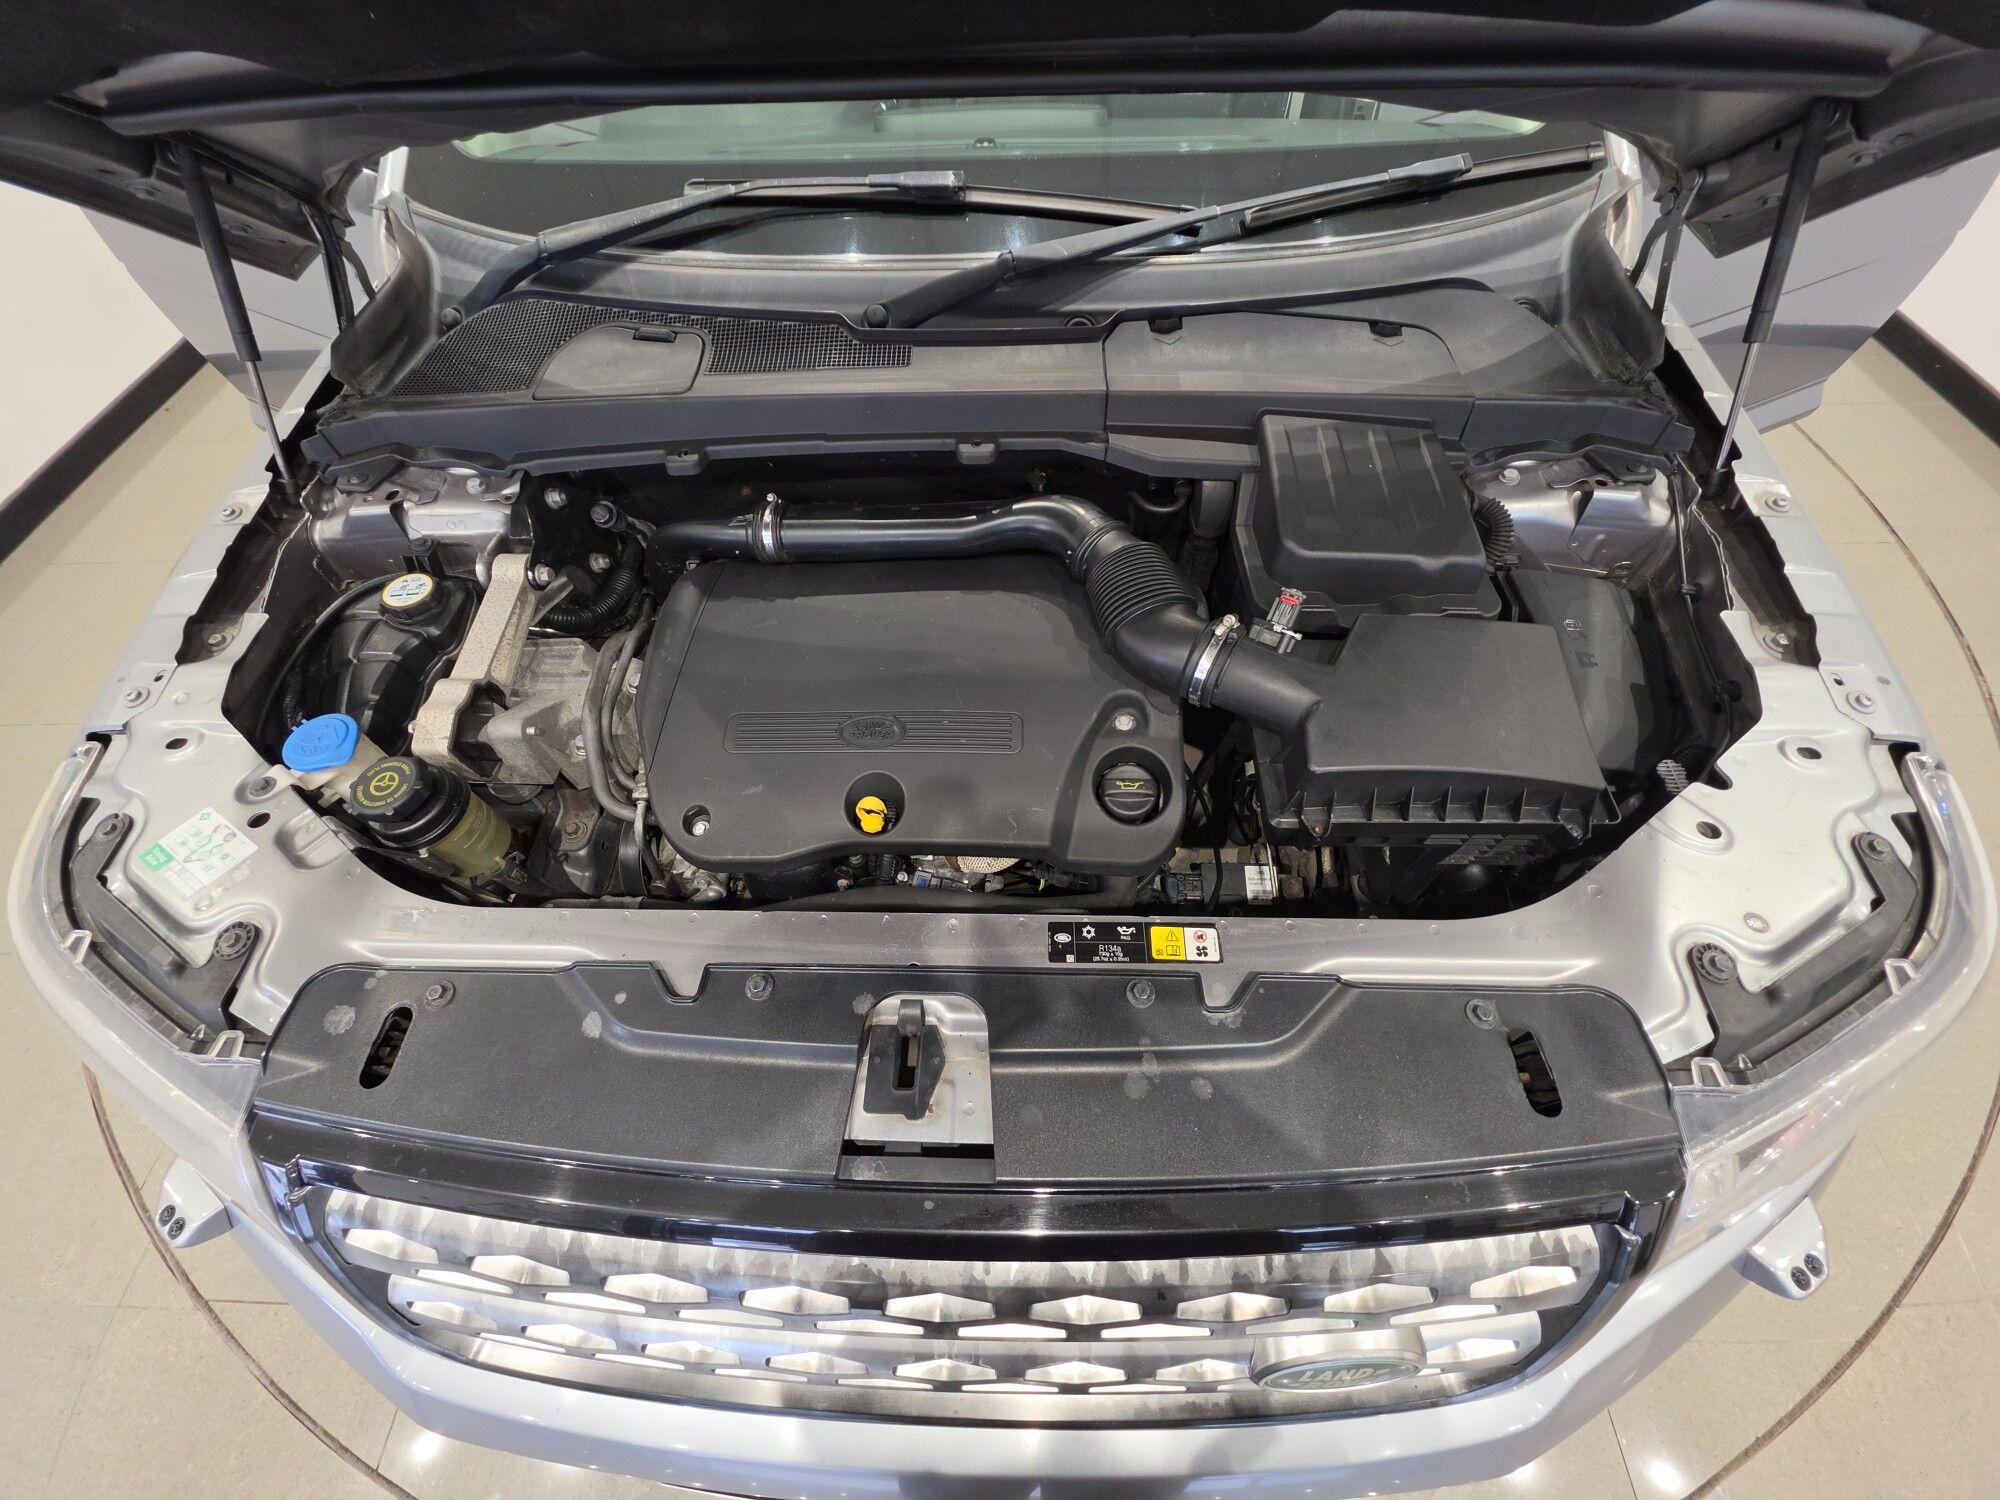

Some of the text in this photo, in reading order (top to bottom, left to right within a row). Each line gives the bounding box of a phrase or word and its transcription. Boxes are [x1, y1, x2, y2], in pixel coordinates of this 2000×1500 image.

[367, 766, 380, 777] FLUID
[1098, 944, 1122, 952] R134a
[1299, 1368, 1374, 1382] LAND
